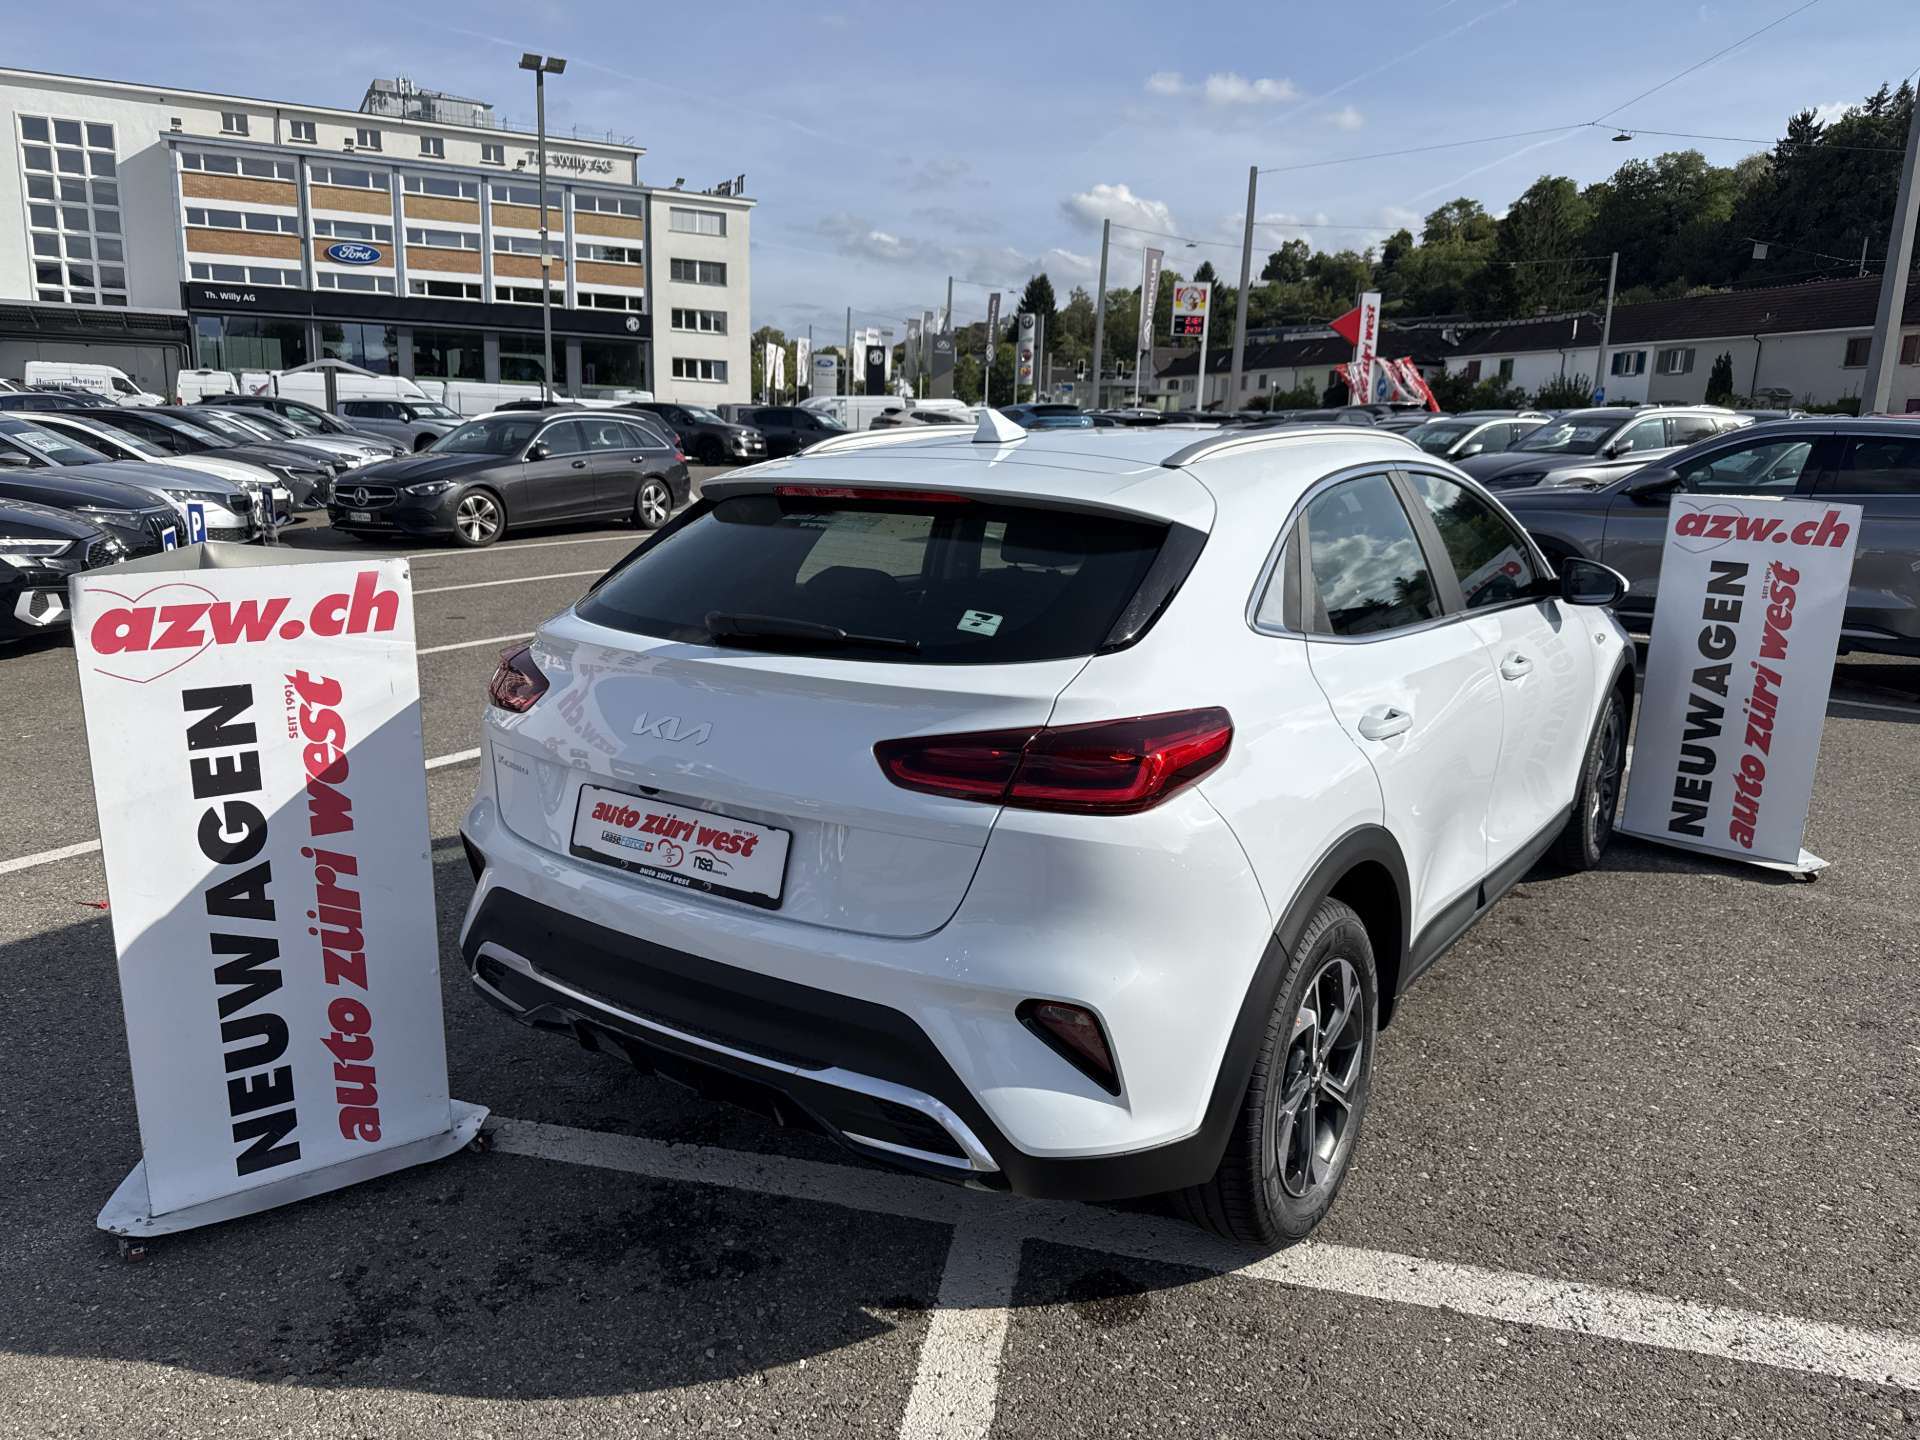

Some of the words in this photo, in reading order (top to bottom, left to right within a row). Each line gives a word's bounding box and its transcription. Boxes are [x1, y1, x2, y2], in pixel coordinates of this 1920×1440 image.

[339, 244, 371, 261] Ford
[204, 290, 218, 300] Th.
[220, 291, 242, 302] Willy
[243, 293, 256, 302] AG
[1364, 303, 1376, 341] west
[191, 511, 202, 541] P
[1675, 510, 1851, 548] azw.ch
[90, 571, 399, 655] azw.ch
[1759, 560, 1800, 660] west
[285, 684, 296, 711] 1991
[1667, 560, 1750, 839] NEUWAGEN
[1743, 660, 1783, 758] züri
[287, 716, 299, 739] SEIT
[632, 711, 713, 746] KIA
[284, 669, 354, 837] west
[1729, 758, 1766, 849] auto
[592, 801, 640, 829] auto
[639, 812, 699, 842] züri
[696, 826, 760, 857] west
[639, 866, 656, 877] auto
[656, 868, 672, 883] züri
[672, 874, 690, 887] west
[693, 855, 713, 871] nsa
[181, 683, 302, 1177] NEUWAGEN
[300, 846, 371, 991] züri
[320, 997, 381, 1143] auto
